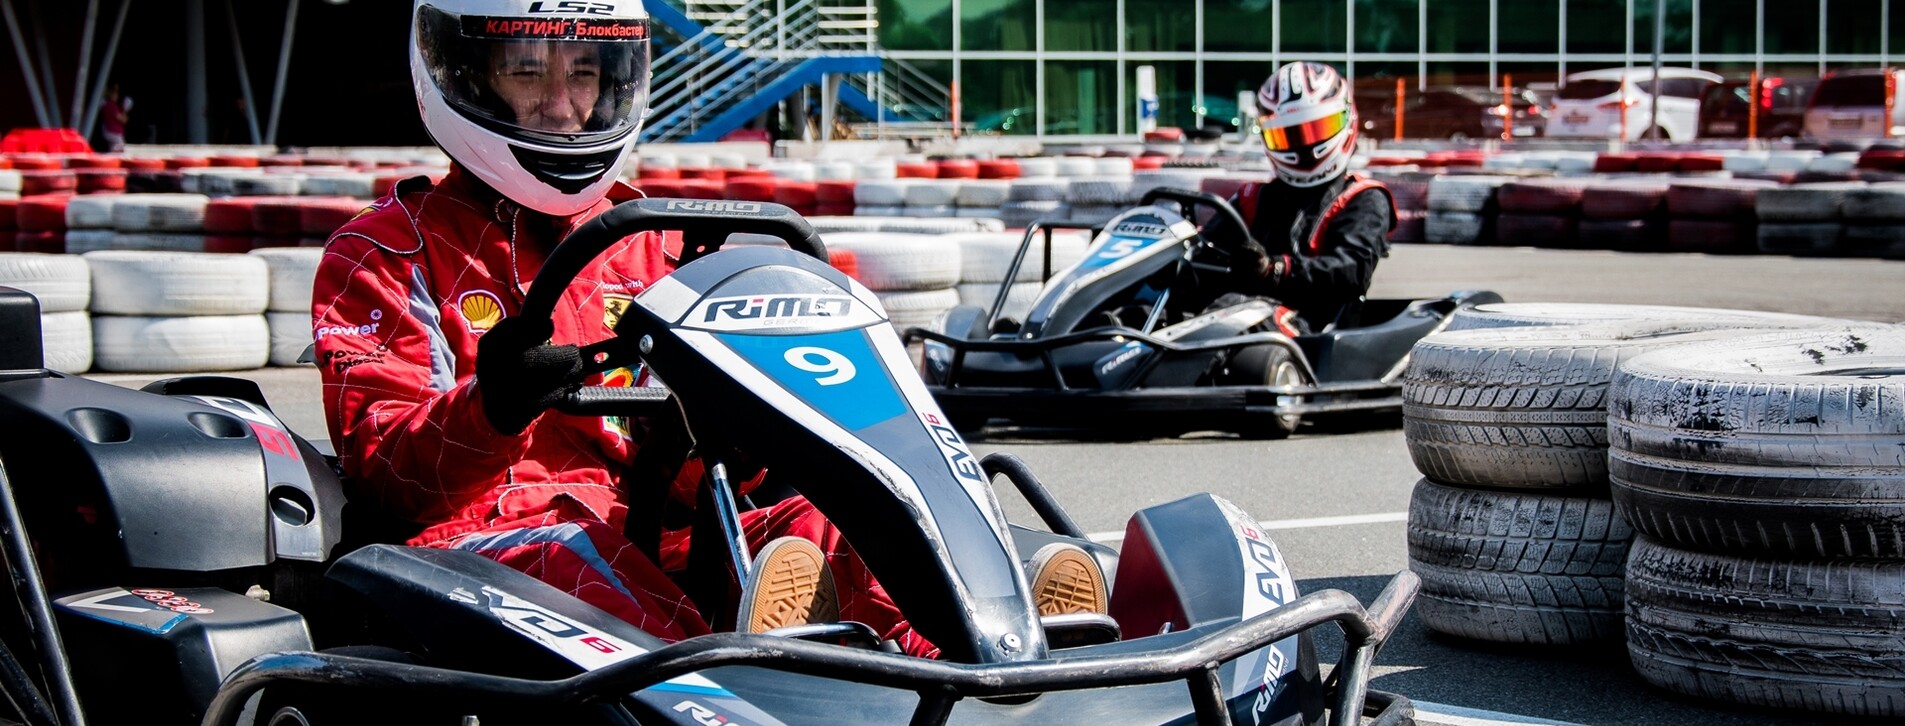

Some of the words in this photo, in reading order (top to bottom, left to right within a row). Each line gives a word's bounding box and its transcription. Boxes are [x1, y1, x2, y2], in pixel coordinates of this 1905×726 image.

[528, 1, 615, 15] LS2
[486, 20, 570, 35] КАРТИНГ
[576, 22, 646, 37] Блокбастер
[1098, 239, 1143, 259] 5
[783, 346, 857, 386] 9
